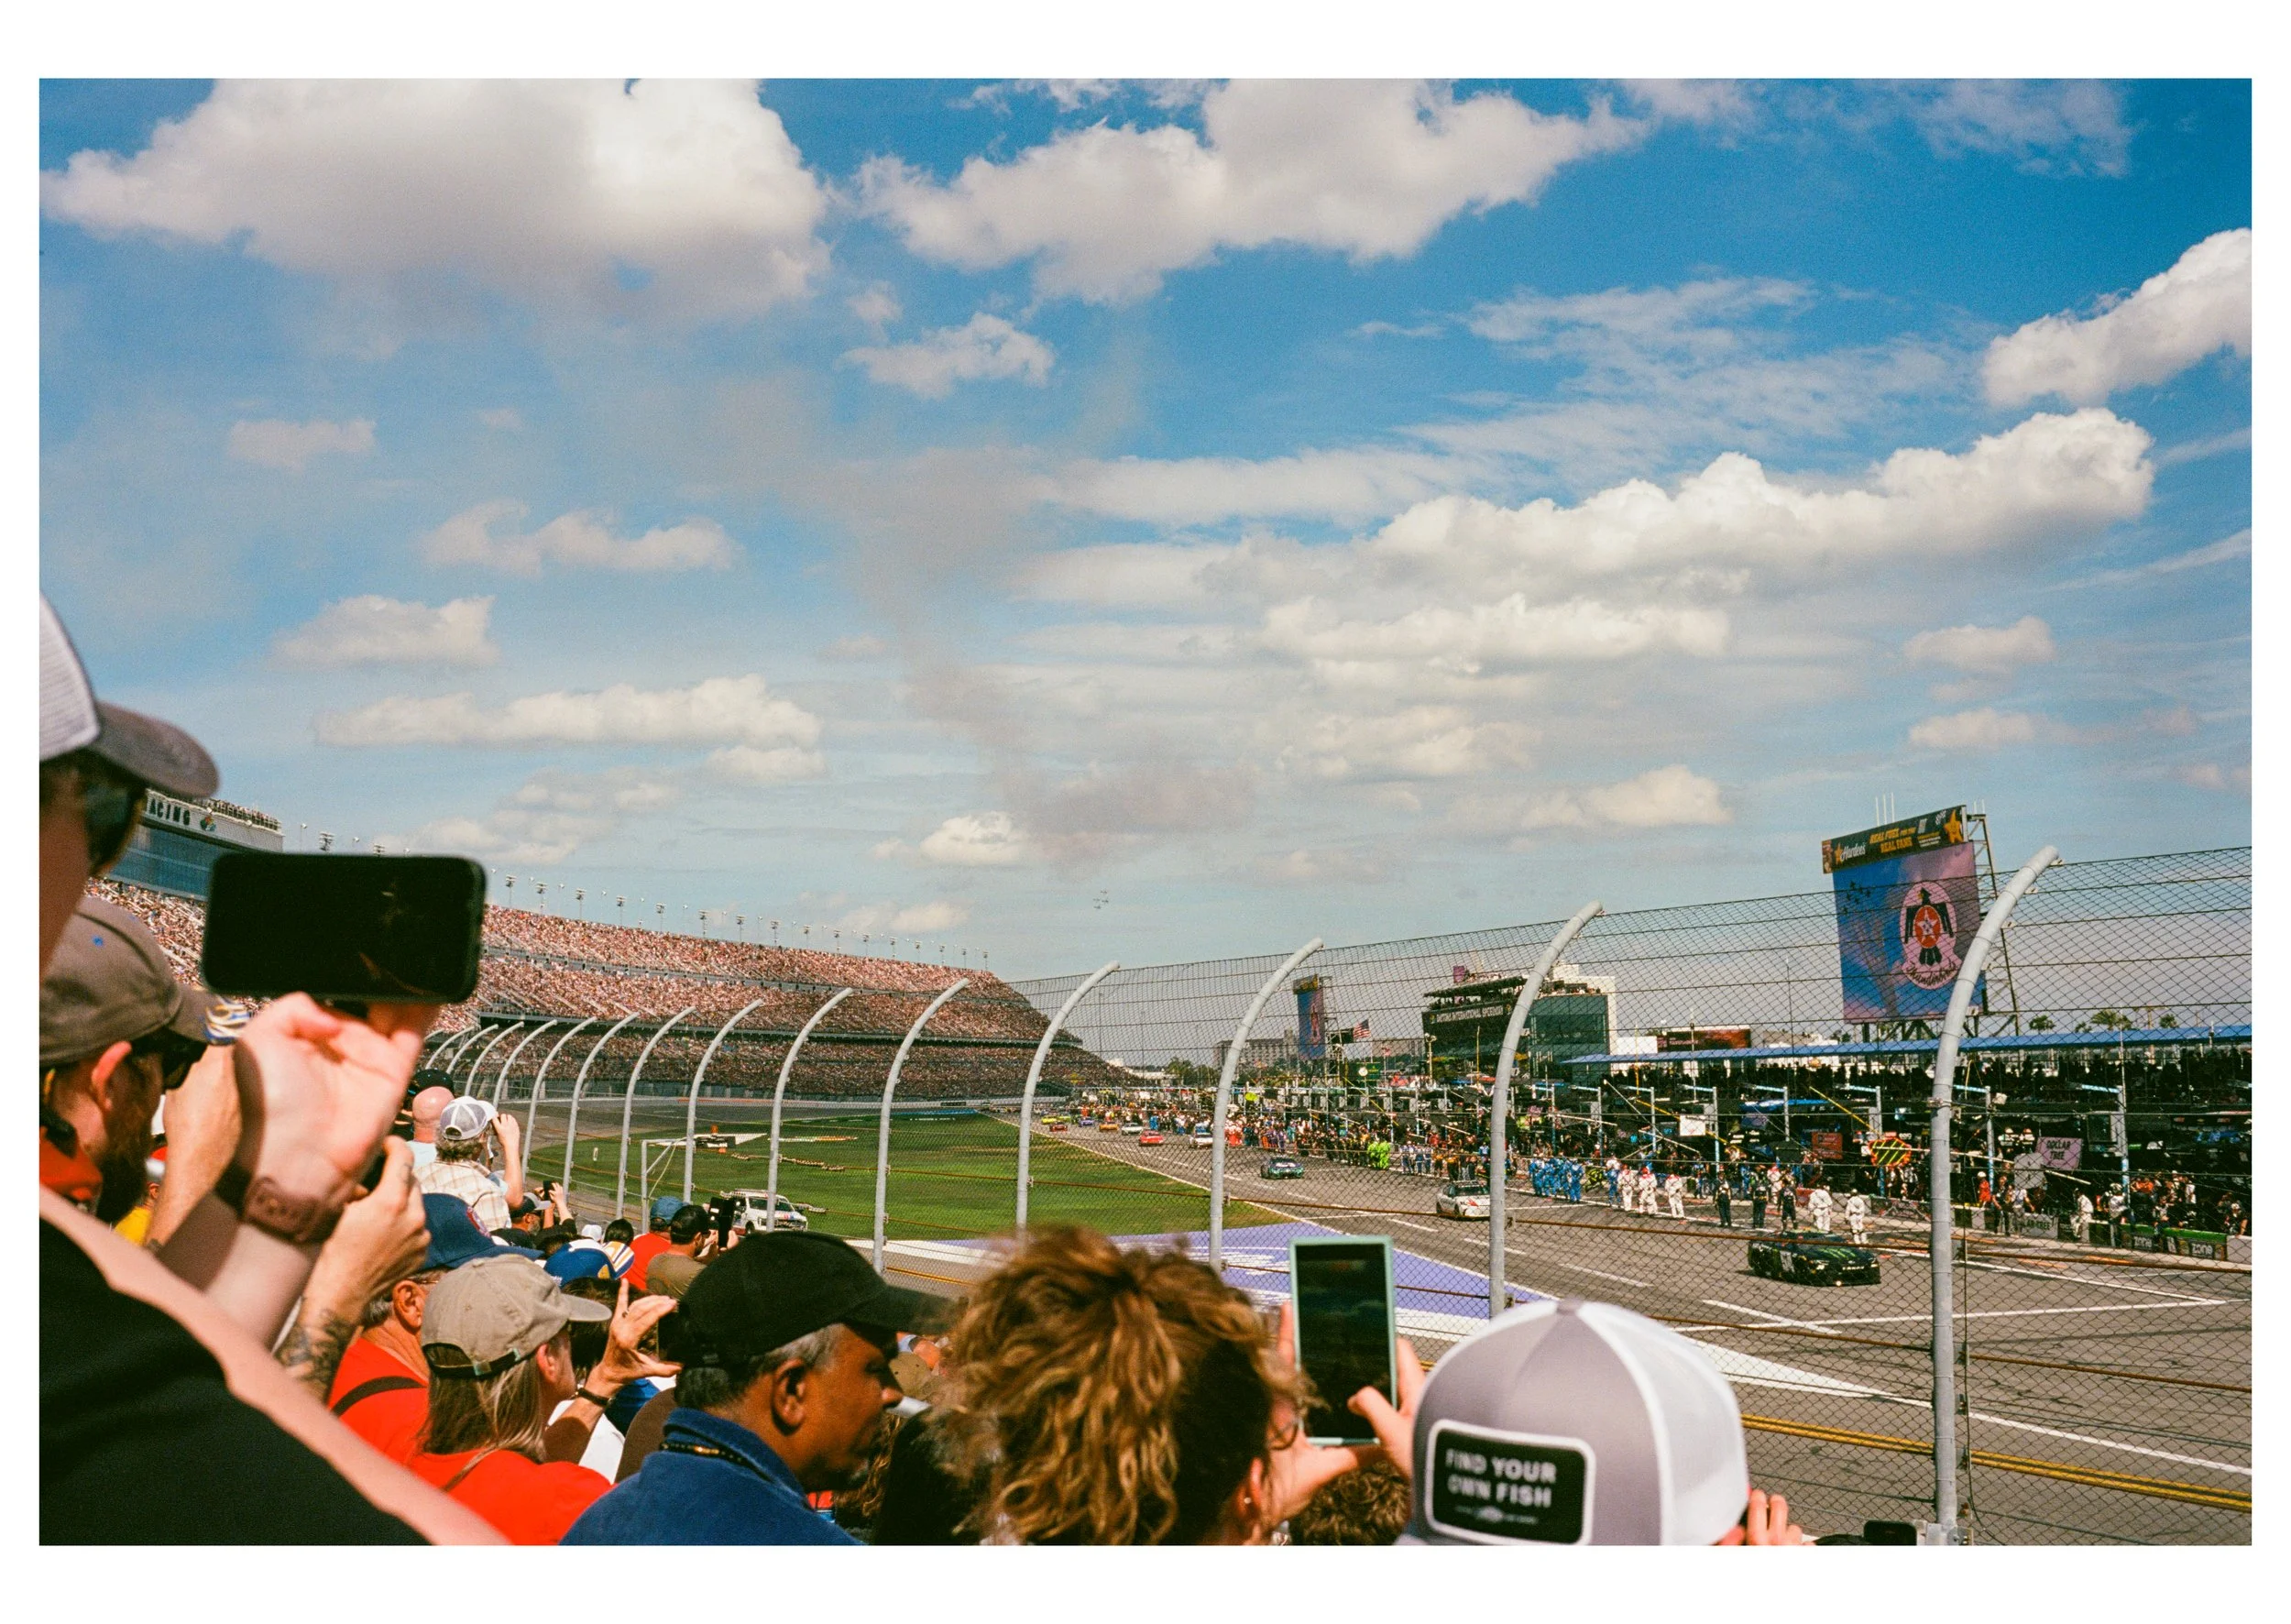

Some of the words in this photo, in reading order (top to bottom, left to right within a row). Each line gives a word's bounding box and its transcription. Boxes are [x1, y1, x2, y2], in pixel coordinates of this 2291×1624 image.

[149, 797, 191, 826] ACING
[2046, 1139, 2071, 1150] DOLLAR
[1445, 1448, 1487, 1476] FIND
[1492, 1455, 1557, 1484] YOUR
[1447, 1473, 1491, 1500] OWN
[1496, 1482, 1551, 1509] FISH
